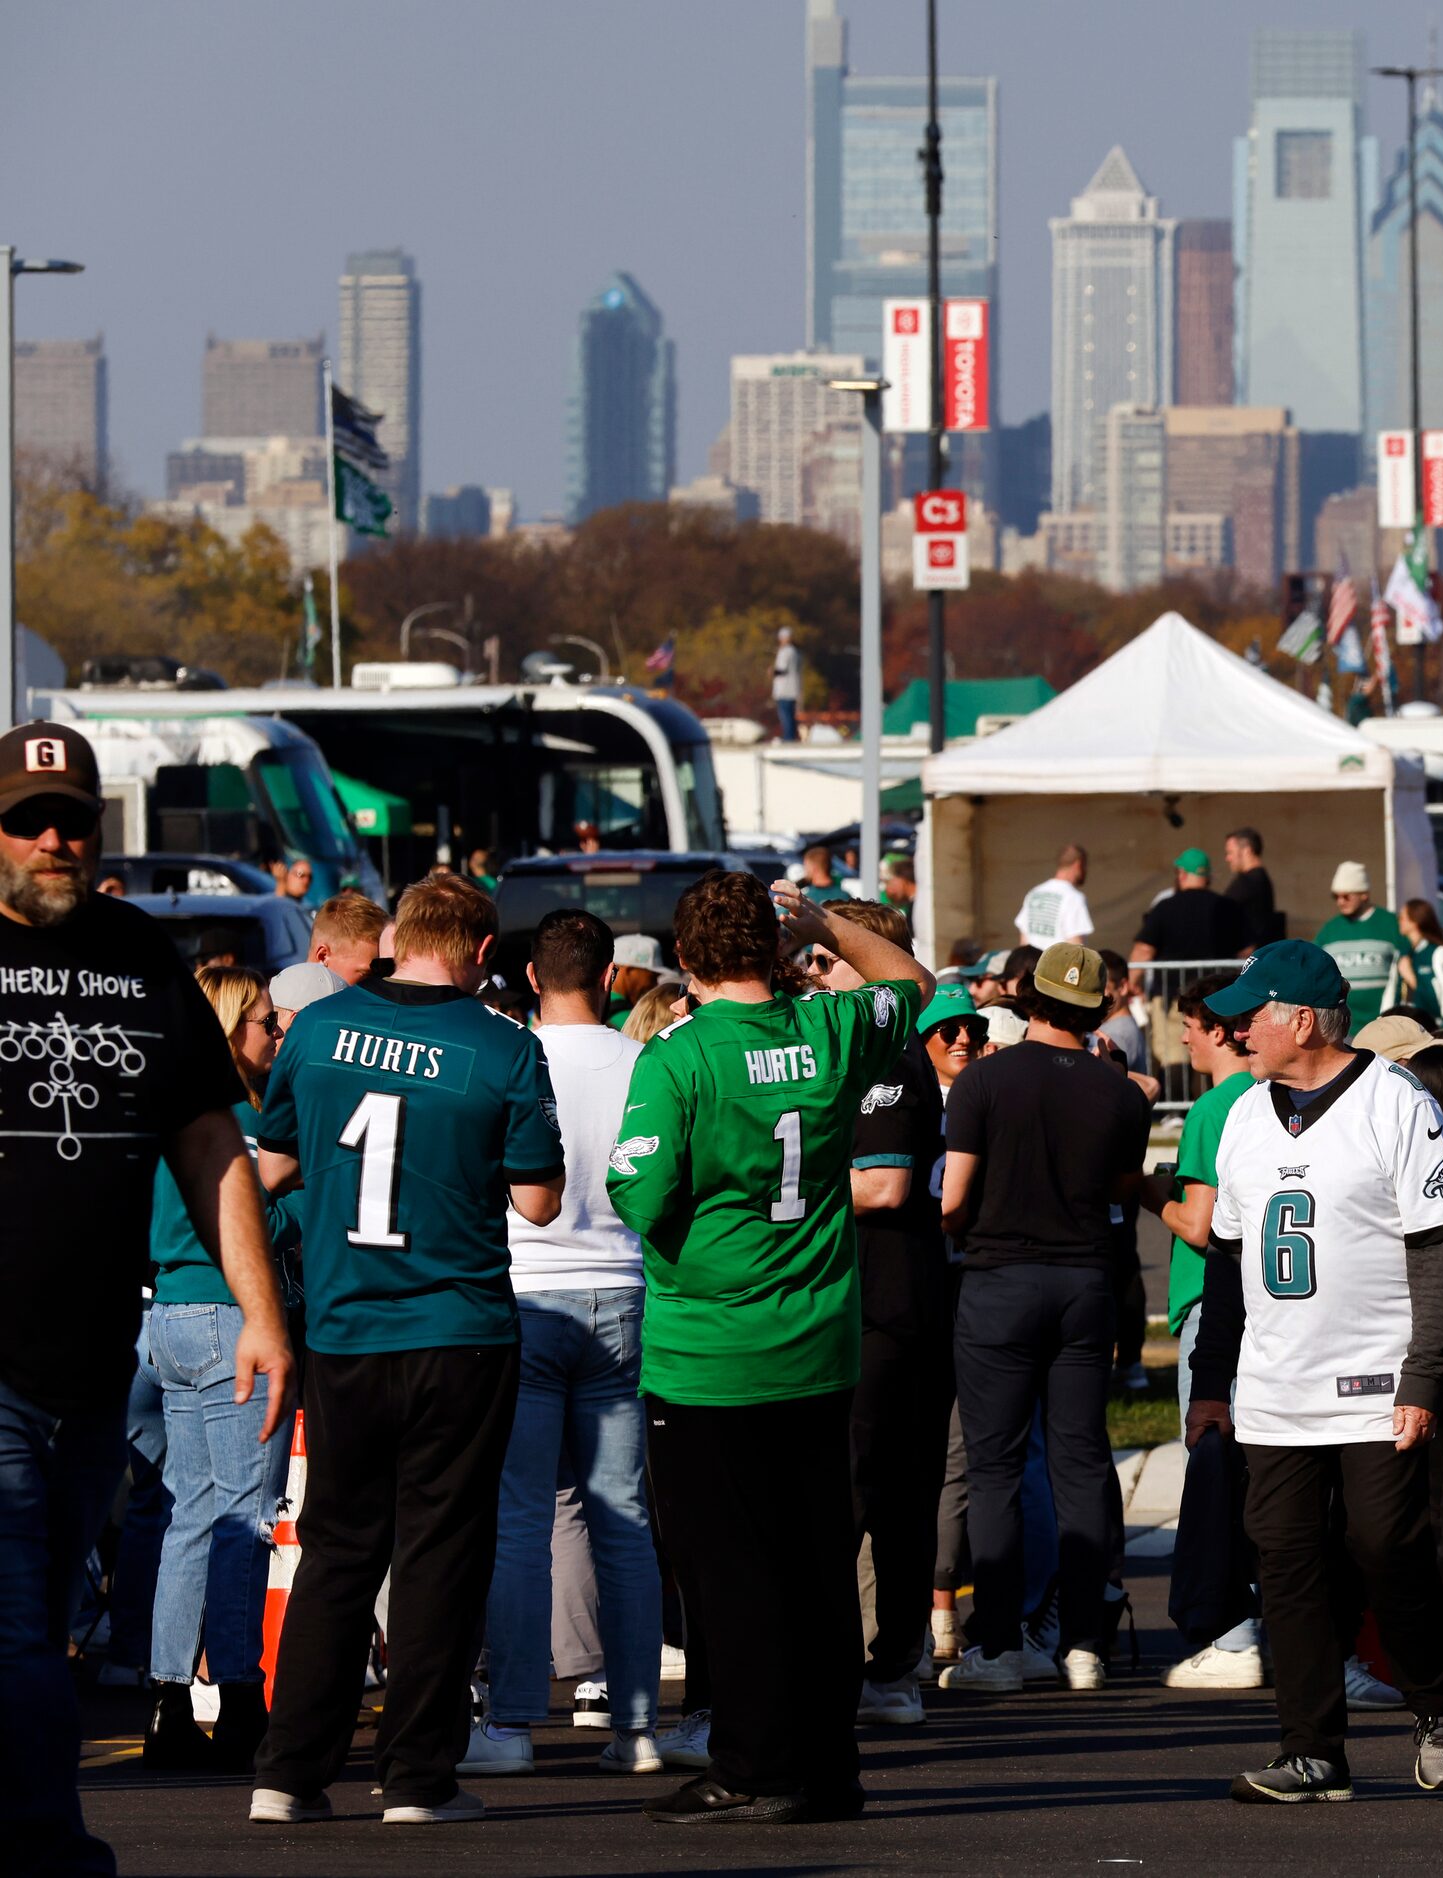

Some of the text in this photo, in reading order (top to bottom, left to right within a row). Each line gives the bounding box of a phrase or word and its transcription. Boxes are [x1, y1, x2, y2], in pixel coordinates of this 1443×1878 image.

[954, 340, 976, 429] TOYOTA
[921, 496, 961, 525] C3
[36, 741, 55, 768] G
[0, 966, 147, 999] HERLY SHOVE
[332, 1028, 444, 1079] HURTS
[744, 1044, 817, 1085] HURTS
[336, 1091, 410, 1250] 1
[770, 1110, 807, 1222] 1
[1261, 1189, 1317, 1300] 6
